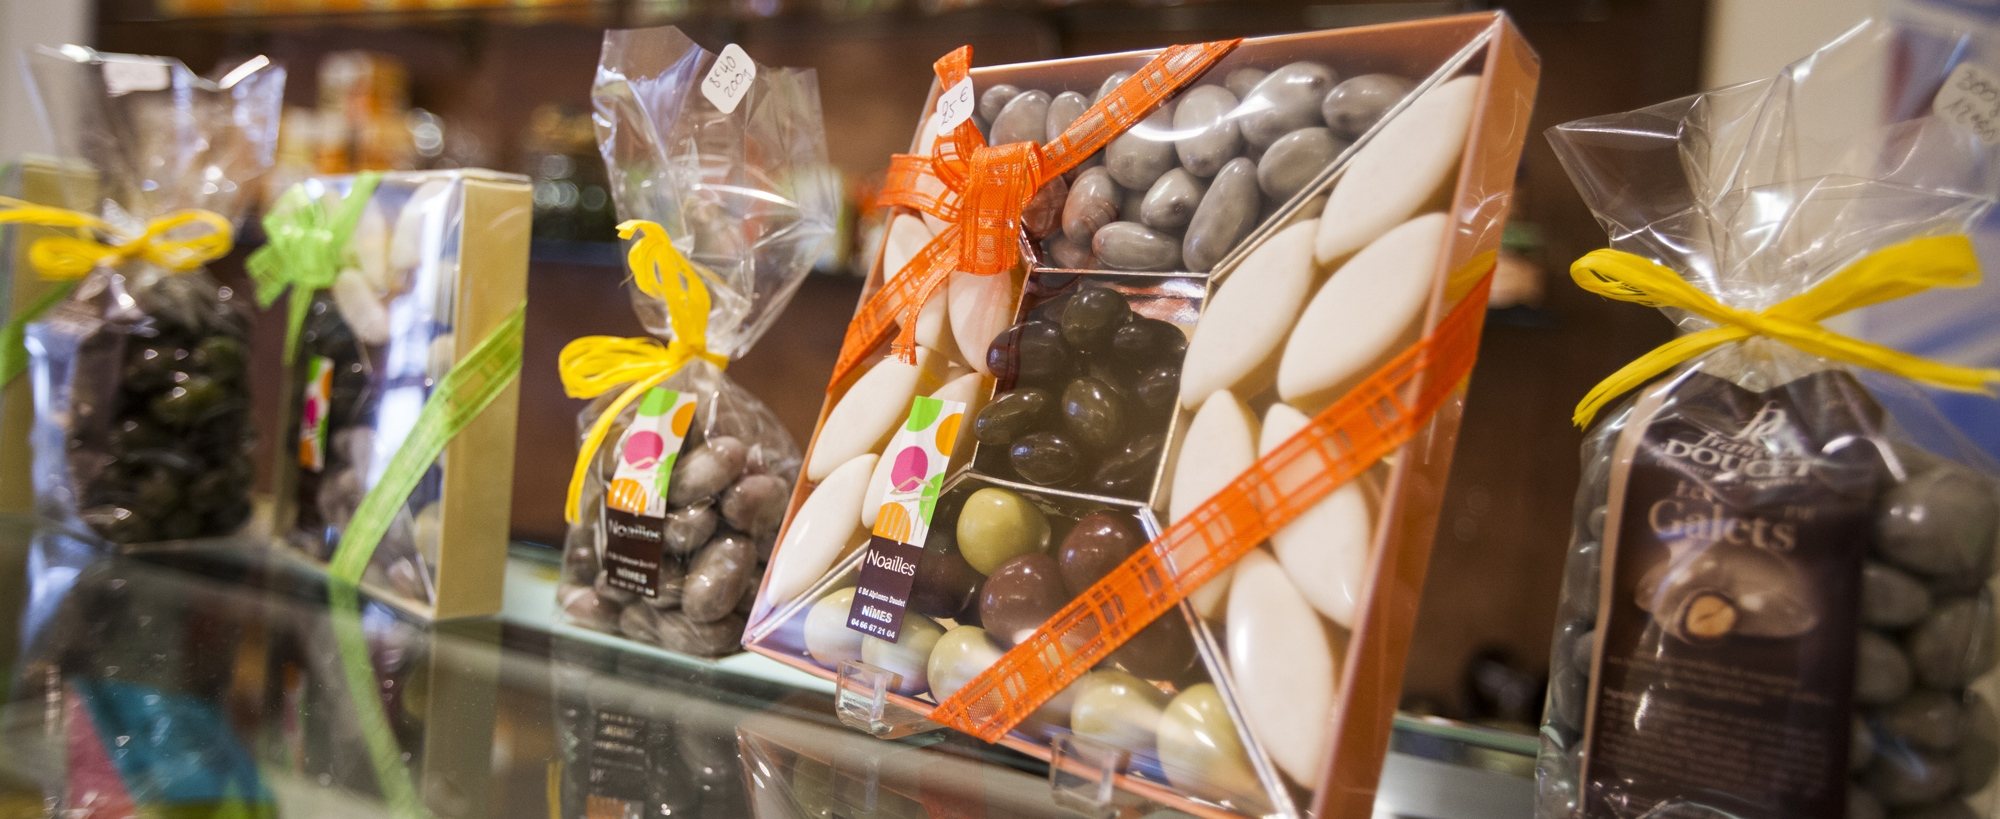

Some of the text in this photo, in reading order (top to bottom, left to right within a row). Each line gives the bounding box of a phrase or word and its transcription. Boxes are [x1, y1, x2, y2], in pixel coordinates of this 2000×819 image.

[723, 68, 753, 98] 200g
[941, 86, 968, 126] 25 €
[1664, 437, 1811, 477] DOUCET
[1647, 499, 1796, 550] Galets
[866, 548, 916, 577] Noailles
[851, 617, 896, 639] 04 66 67 21 04
[861, 604, 893, 624] NÎMES
